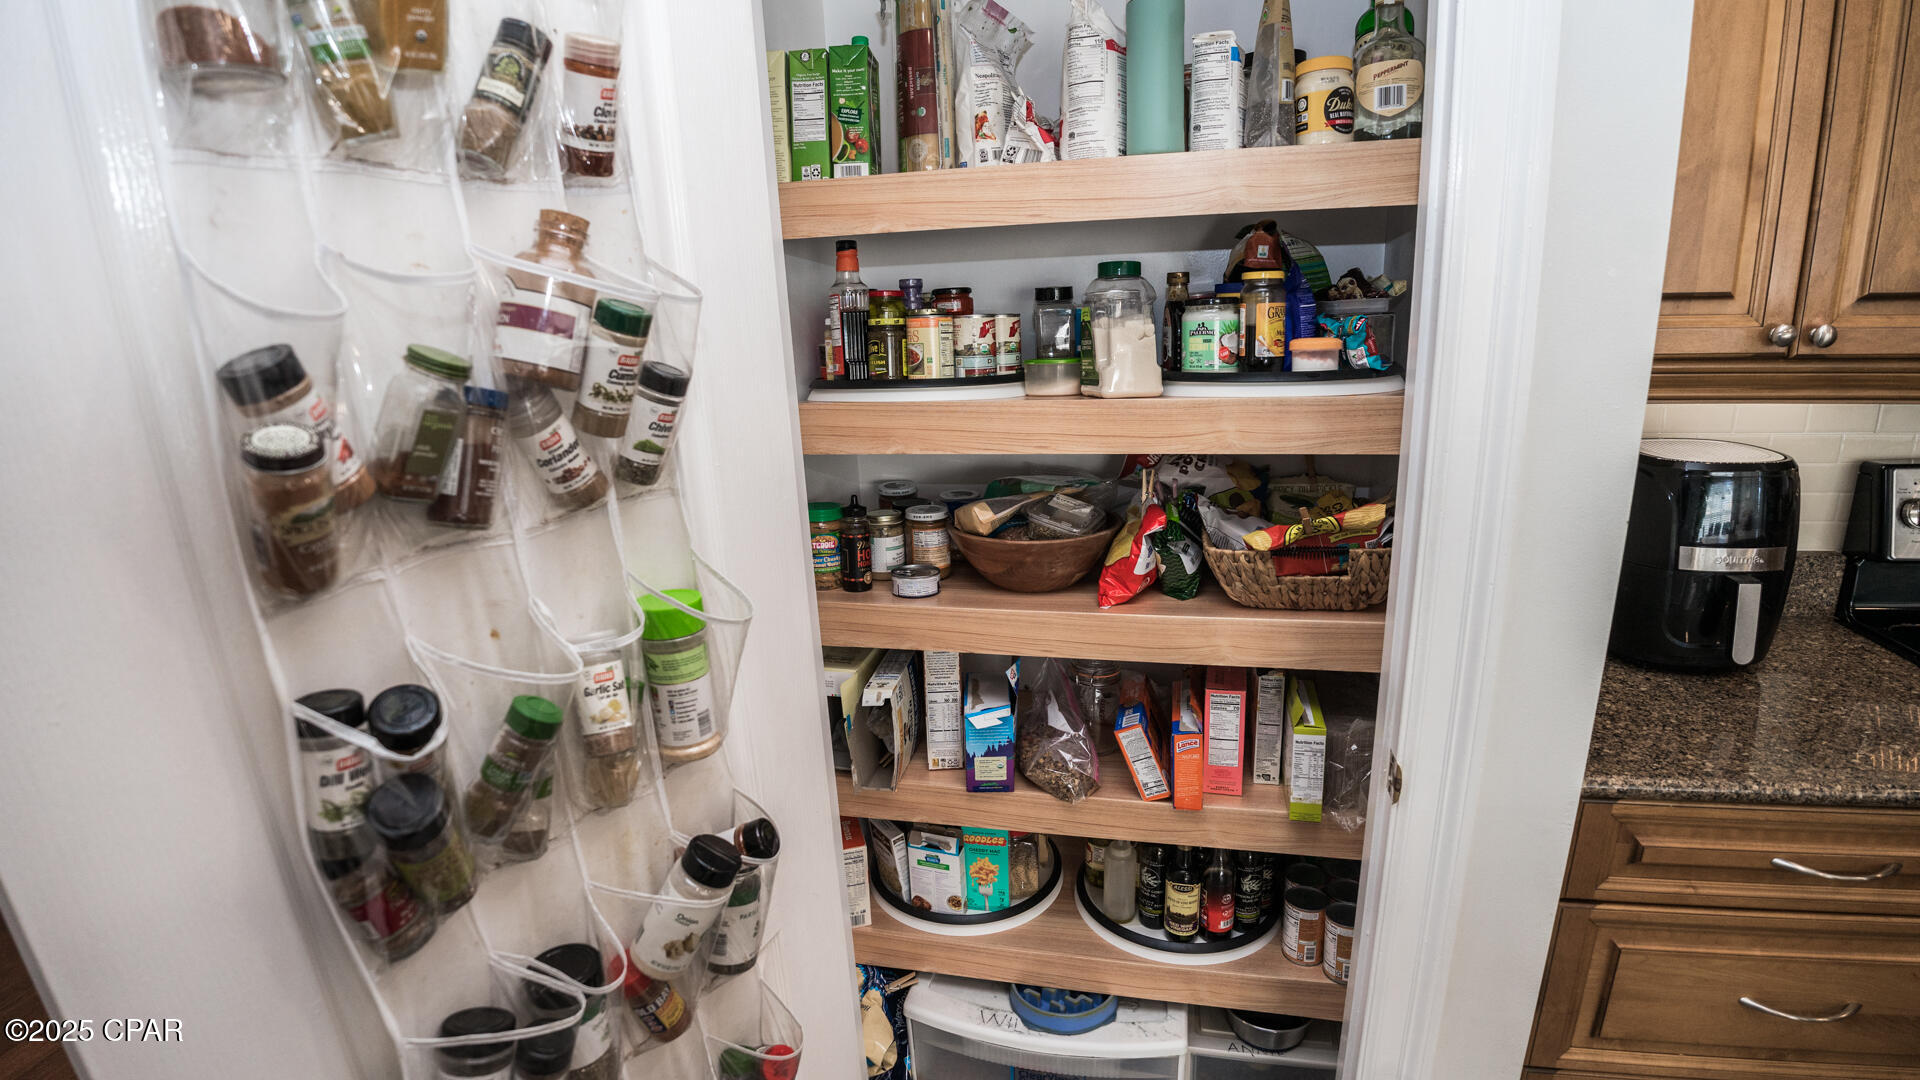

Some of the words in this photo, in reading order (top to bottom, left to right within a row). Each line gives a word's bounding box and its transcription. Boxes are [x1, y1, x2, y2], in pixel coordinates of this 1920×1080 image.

[1373, 61, 1409, 80] PEPPERMINT
[584, 685, 611, 697] Garlic
[1177, 740, 1198, 750] Lance
[319, 774, 345, 788] Dill
[963, 834, 1006, 845] GOODLES
[1173, 884, 1193, 892] ALESSI
[676, 913, 699, 924] Onion
